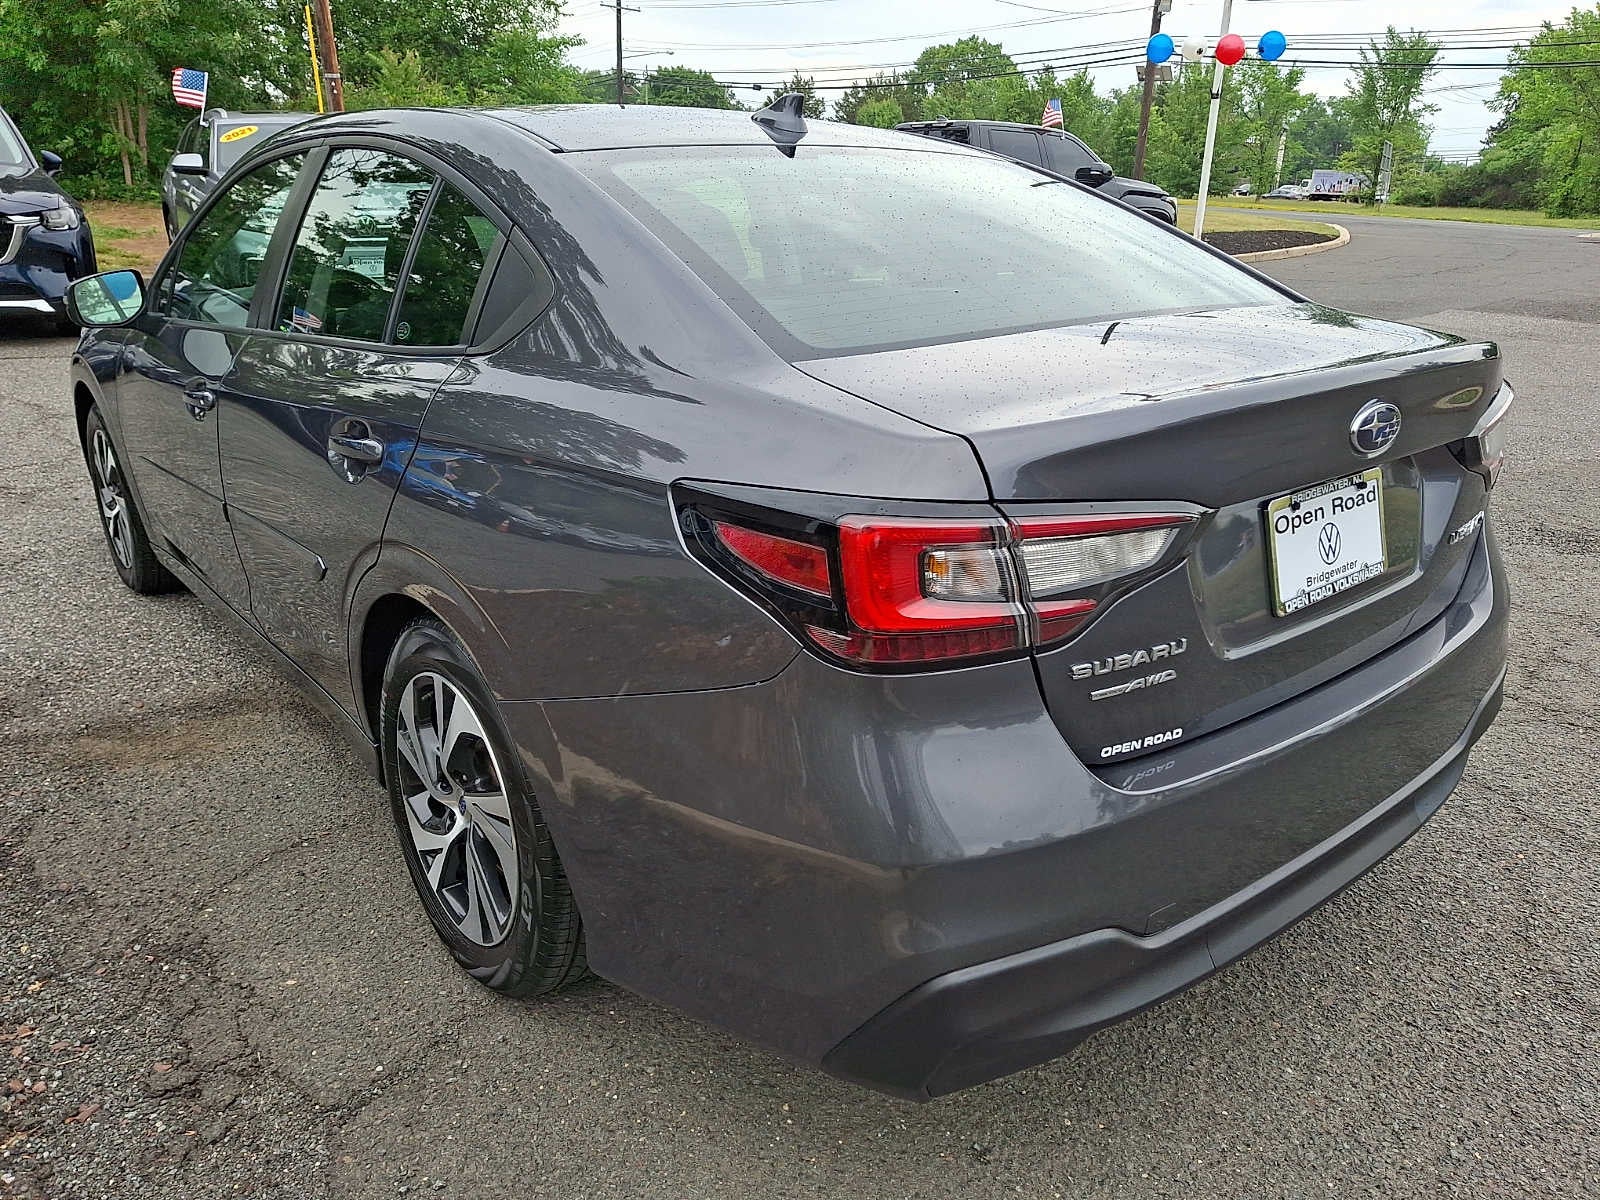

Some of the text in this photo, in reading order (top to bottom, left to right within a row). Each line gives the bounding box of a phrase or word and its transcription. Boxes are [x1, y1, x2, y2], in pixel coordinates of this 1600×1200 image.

[225, 127, 252, 141] 2021
[1275, 485, 1377, 534] Open Road
[1285, 561, 1384, 613] OPEN ROAD VOLKSWAGEN
[1306, 559, 1358, 588] Bridgewater
[1071, 637, 1188, 680] SUBARU
[1126, 669, 1177, 693] AWD
[1100, 728, 1184, 758] OPEN ROAD
